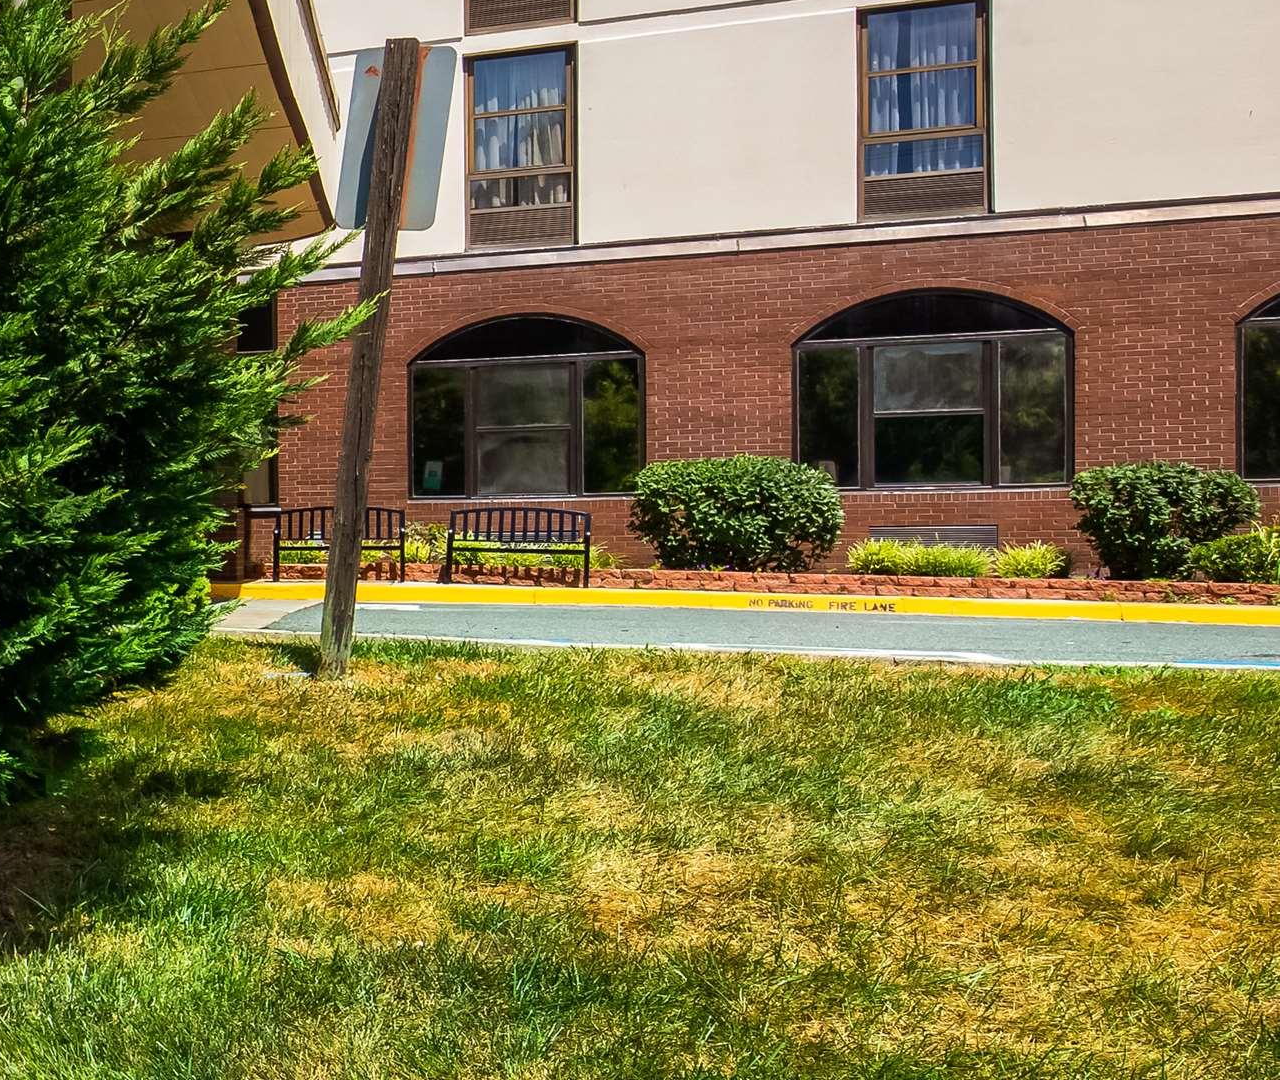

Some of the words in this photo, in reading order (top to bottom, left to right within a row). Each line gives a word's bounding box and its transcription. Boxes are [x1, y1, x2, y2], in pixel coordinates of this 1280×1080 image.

[748, 598, 764, 608] NO
[768, 598, 815, 610] PARKING
[828, 600, 857, 612] FIRE
[864, 601, 897, 613] LANE
